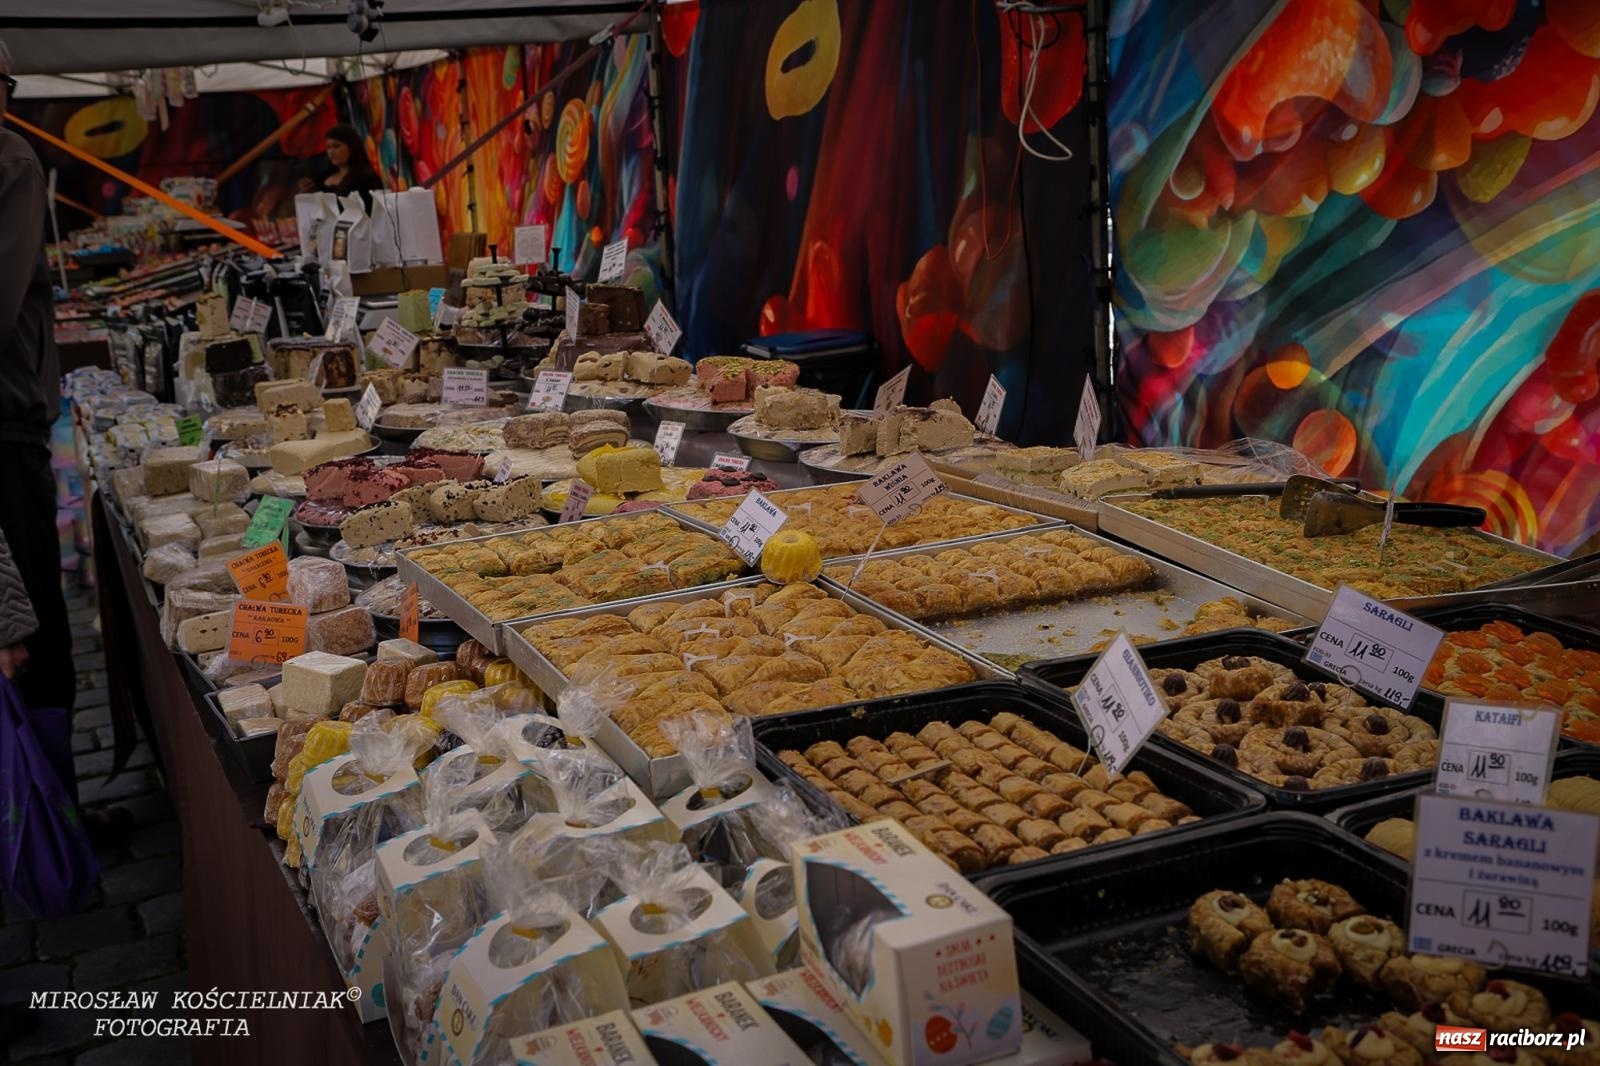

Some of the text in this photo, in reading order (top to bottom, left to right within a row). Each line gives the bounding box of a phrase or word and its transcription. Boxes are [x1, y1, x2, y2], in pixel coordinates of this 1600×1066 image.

[873, 463, 907, 488] BAKLAWA
[755, 497, 777, 517] BAKLAWA
[1363, 602, 1414, 632] SARAGLI
[232, 631, 249, 639] CENA
[1319, 631, 1344, 648] CENA
[1392, 666, 1415, 684] 100g
[1475, 710, 1522, 726] KATAIFI
[1441, 762, 1464, 774] CENA
[1515, 772, 1539, 787] 100g
[1459, 807, 1555, 831] BAKLAWA
[872, 827, 917, 857] BARANEK
[1464, 831, 1547, 853] SARAGLI
[1435, 848, 1493, 864] kremem
[1497, 855, 1585, 877] bananowym
[1416, 902, 1456, 918] CENA
[1543, 919, 1579, 937] 100g
[714, 992, 760, 1031] BARANEK
